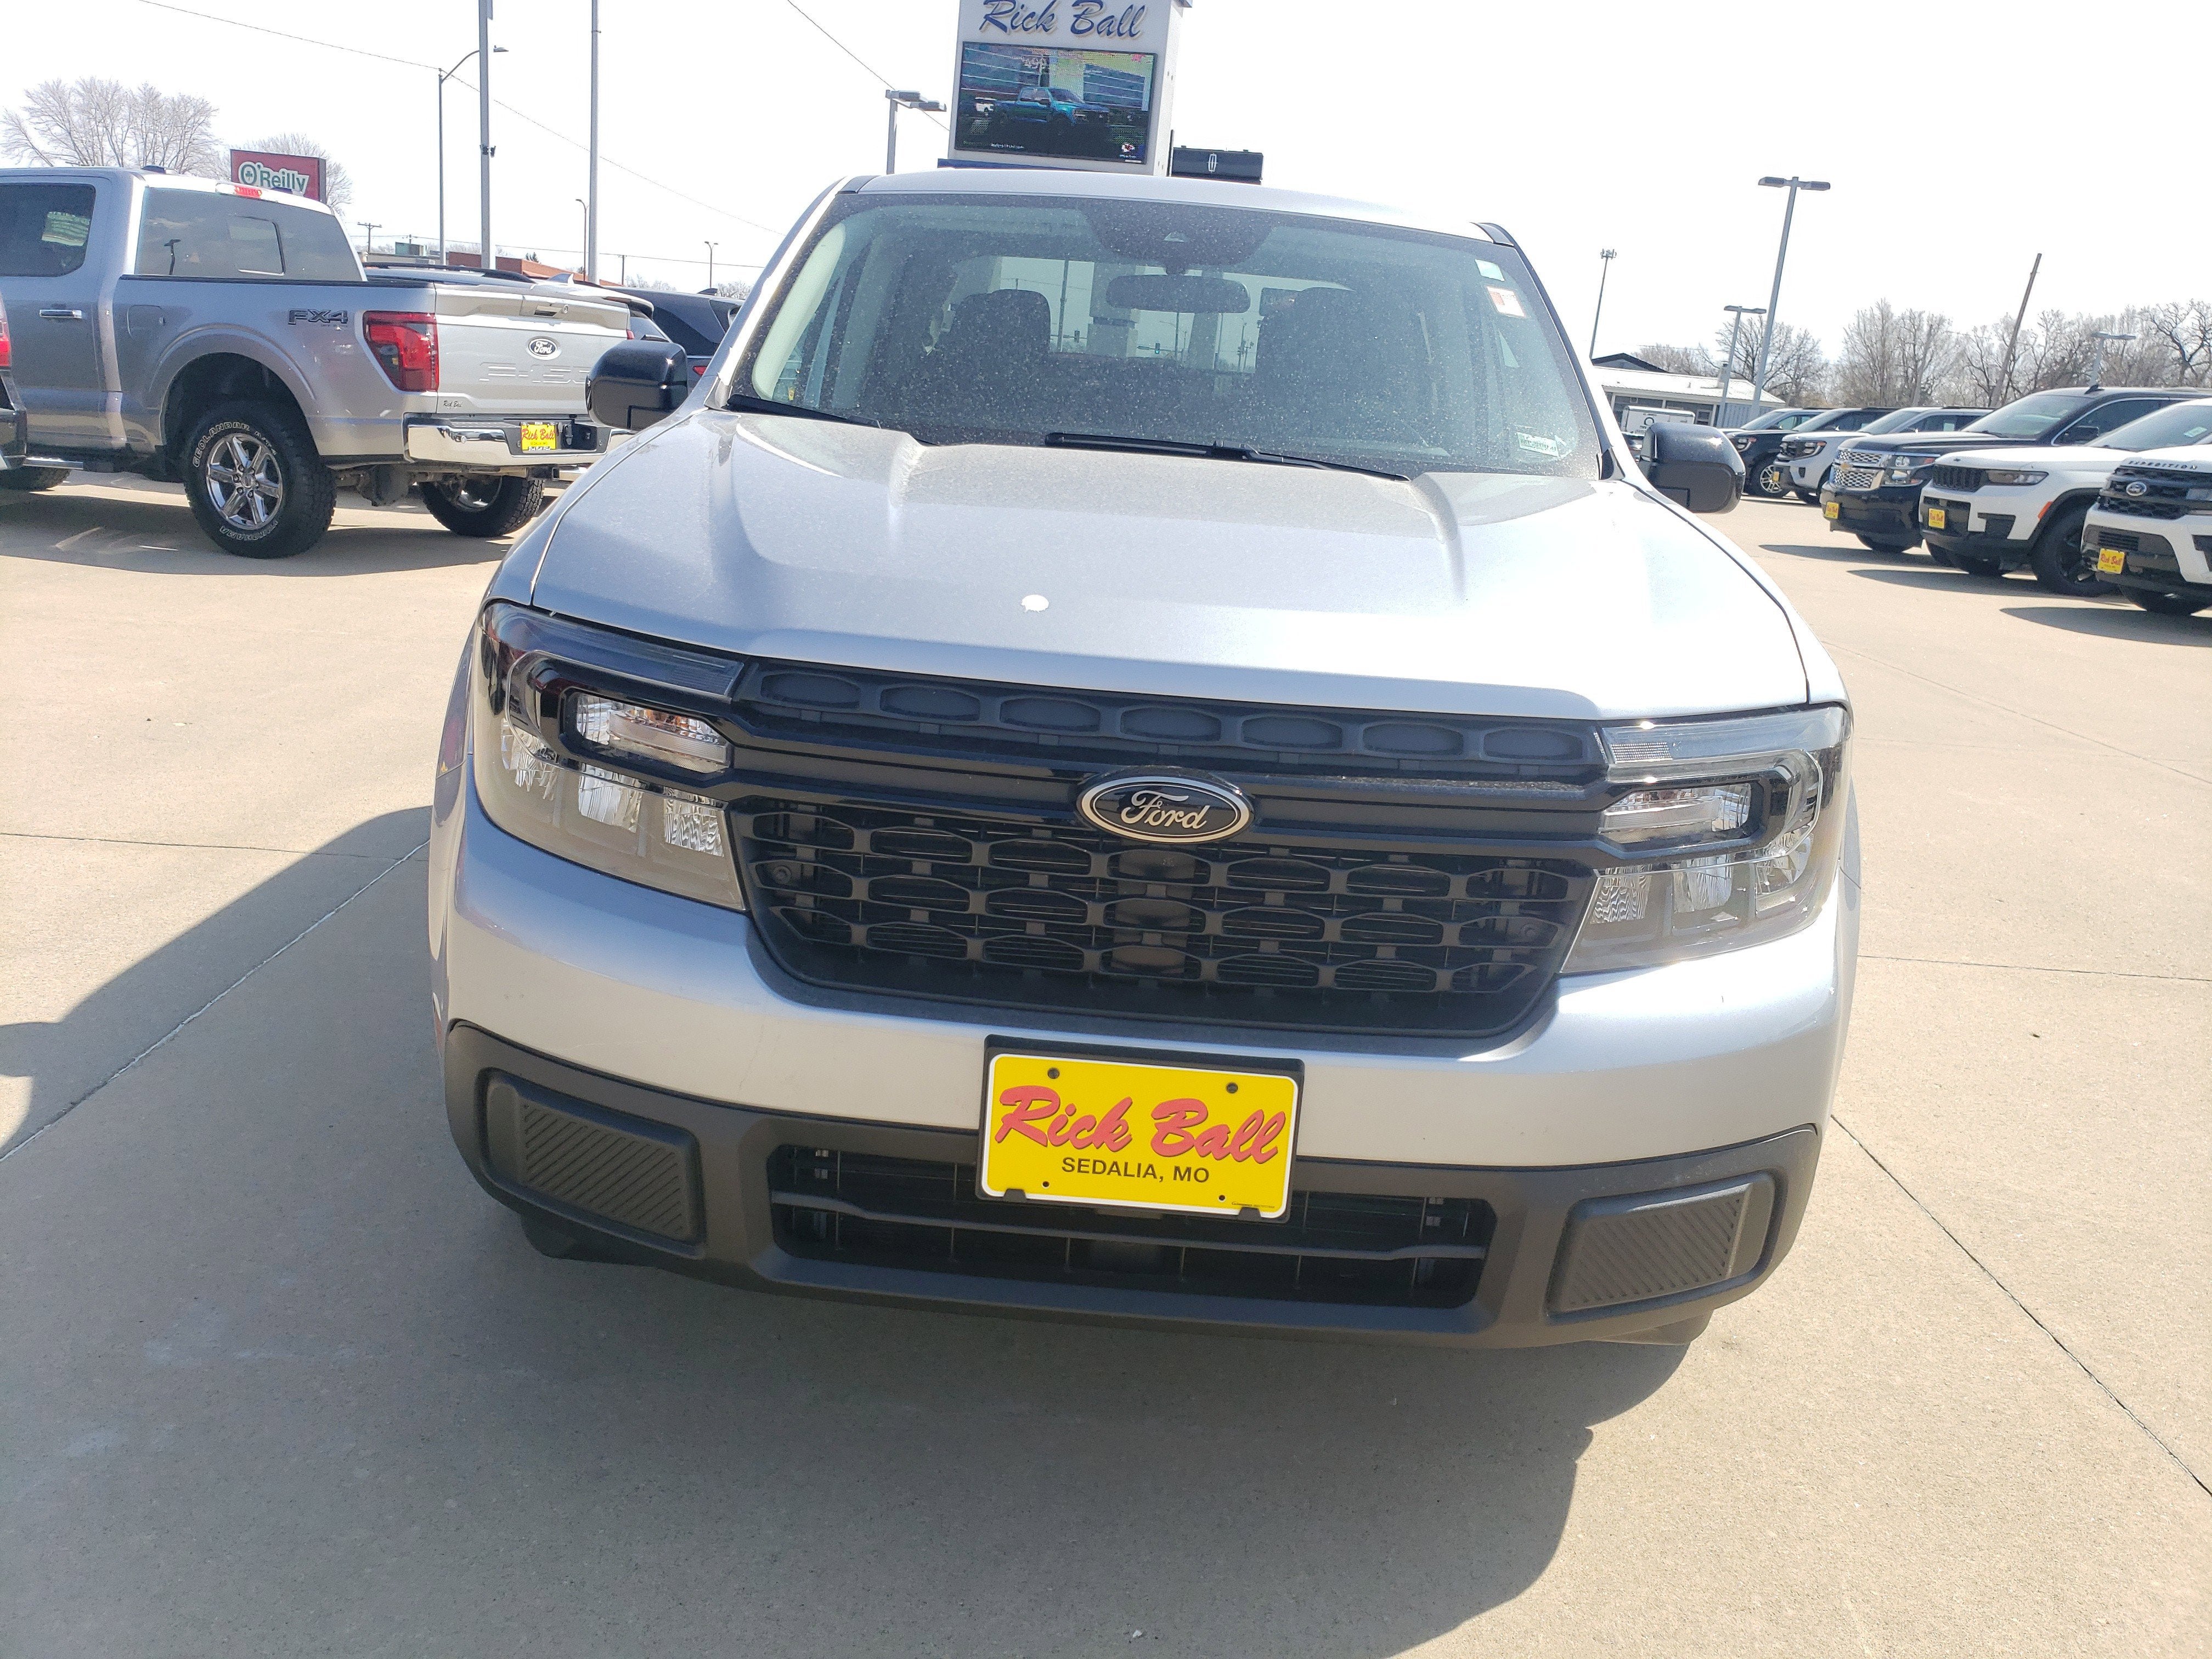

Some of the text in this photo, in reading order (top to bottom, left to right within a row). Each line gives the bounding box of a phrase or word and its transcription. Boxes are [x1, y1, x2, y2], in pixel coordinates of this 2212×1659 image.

[979, 0, 1147, 37] Rick Ball
[240, 163, 306, 192] O'Reilly
[288, 308, 348, 325] FX4
[534, 341, 553, 354] Ford
[193, 421, 250, 467] GEOLANDAR
[522, 428, 555, 440] Rick Ball
[2129, 460, 2198, 470] EXPEDITION
[1121, 790, 1210, 829] Ford
[994, 1085, 1286, 1164] Rick Ball
[1062, 1156, 1209, 1183] SEDALIA, MO
